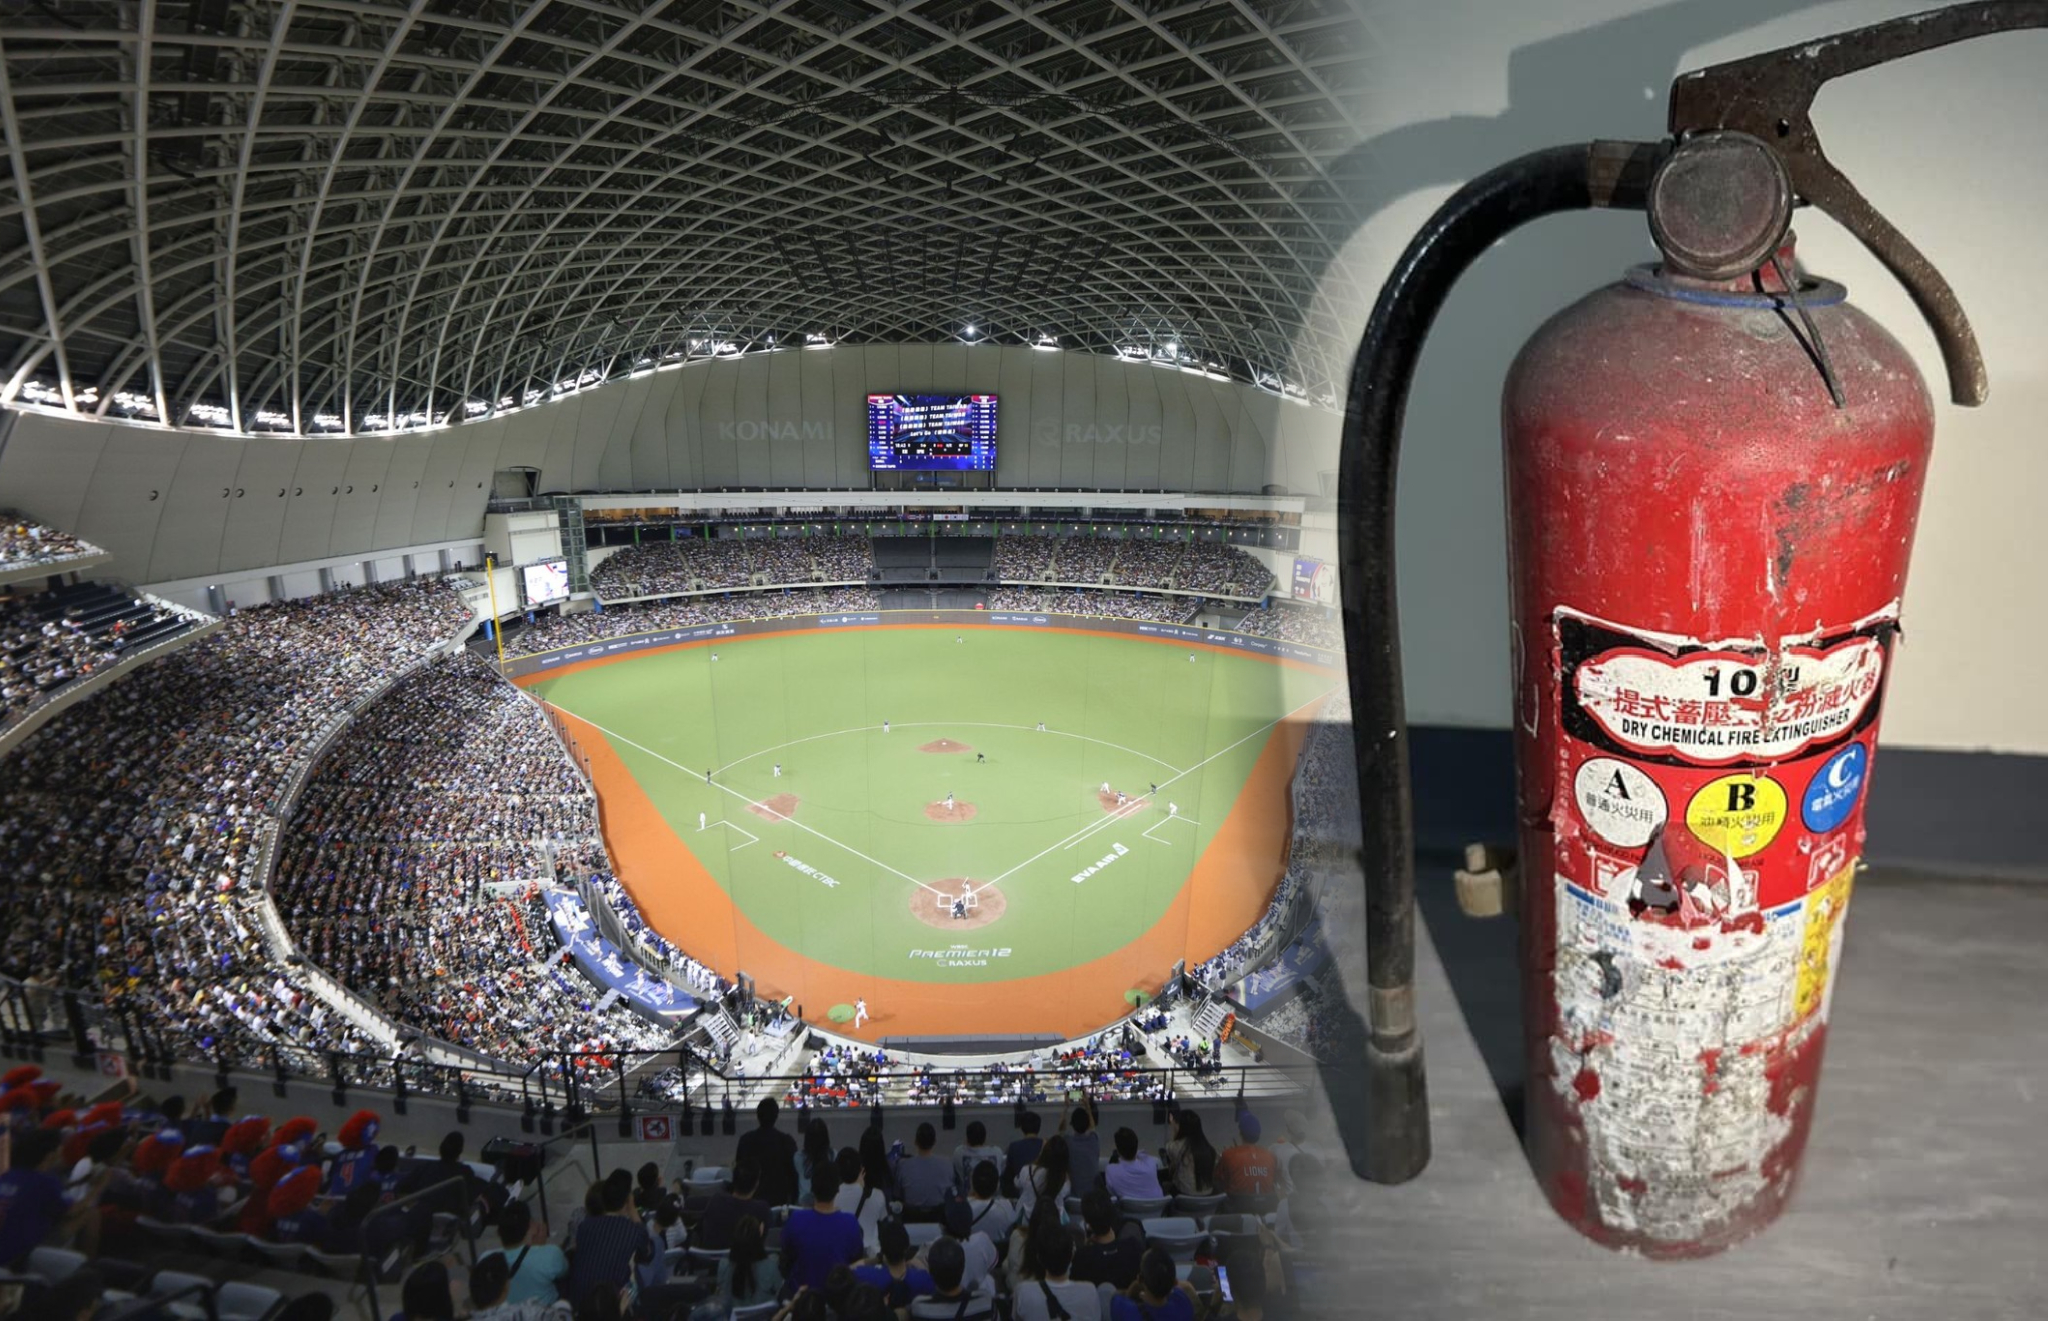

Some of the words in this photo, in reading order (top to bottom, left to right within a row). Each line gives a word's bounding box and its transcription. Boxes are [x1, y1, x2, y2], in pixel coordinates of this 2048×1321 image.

[719, 420, 834, 440] KONAMI
[1066, 423, 1162, 443] RAXUS
[1622, 718, 1648, 738] DRY
[1651, 724, 1725, 746] CHEMICAL
[1728, 730, 1760, 745] FIRE
[1828, 749, 1857, 789] C
[1604, 768, 1632, 801] A
[1726, 783, 1757, 812] B
[812, 872, 841, 889] CTBC
[1070, 866, 1100, 884] EVA
[1095, 853, 1119, 869] AIR
[948, 959, 987, 967] RAXUS
[1244, 1165, 1268, 1177] LIONS
